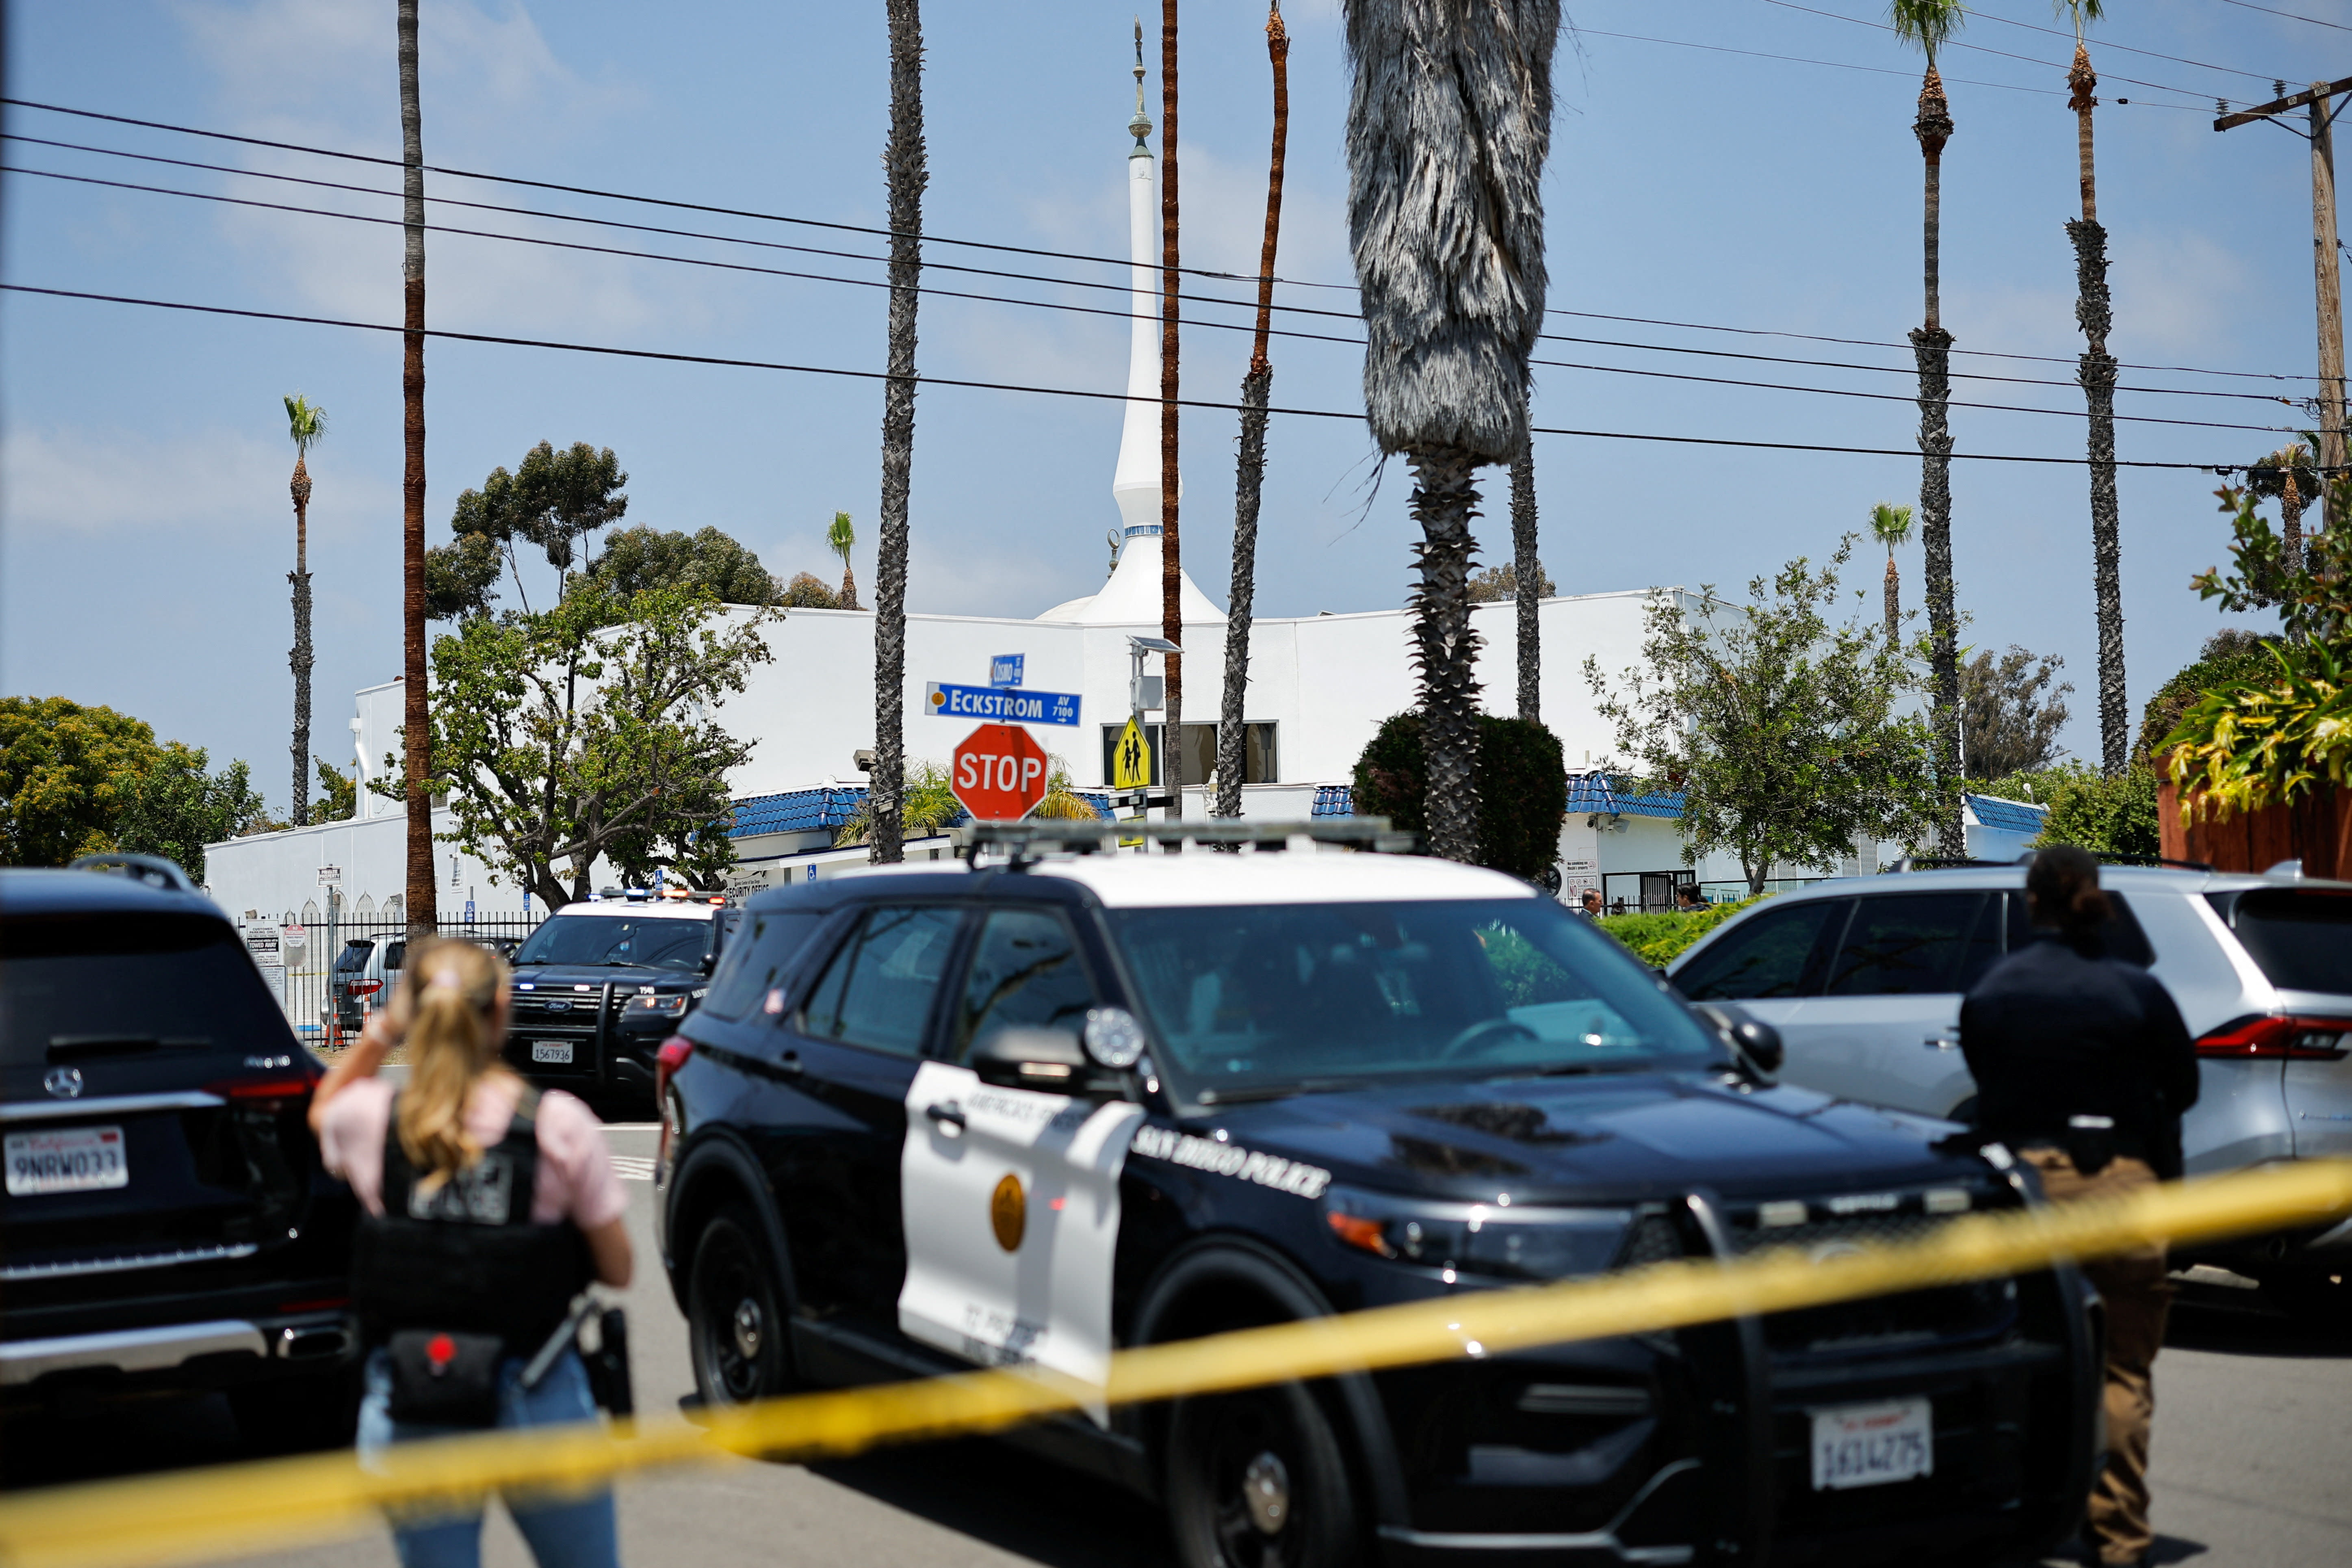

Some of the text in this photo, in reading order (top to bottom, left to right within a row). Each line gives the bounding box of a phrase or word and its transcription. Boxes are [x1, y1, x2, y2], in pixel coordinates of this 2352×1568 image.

[994, 661, 1013, 682] COSMO
[950, 690, 1043, 718] ECKSTROM
[1057, 696, 1070, 706] AV
[1053, 706, 1073, 718] 7100
[958, 753, 1042, 792] STOP
[726, 884, 769, 898] SECURITY OFFICE
[1570, 885, 1577, 897] NO
[535, 1049, 570, 1060] 1567936
[1237, 1150, 1332, 1200] POLICE
